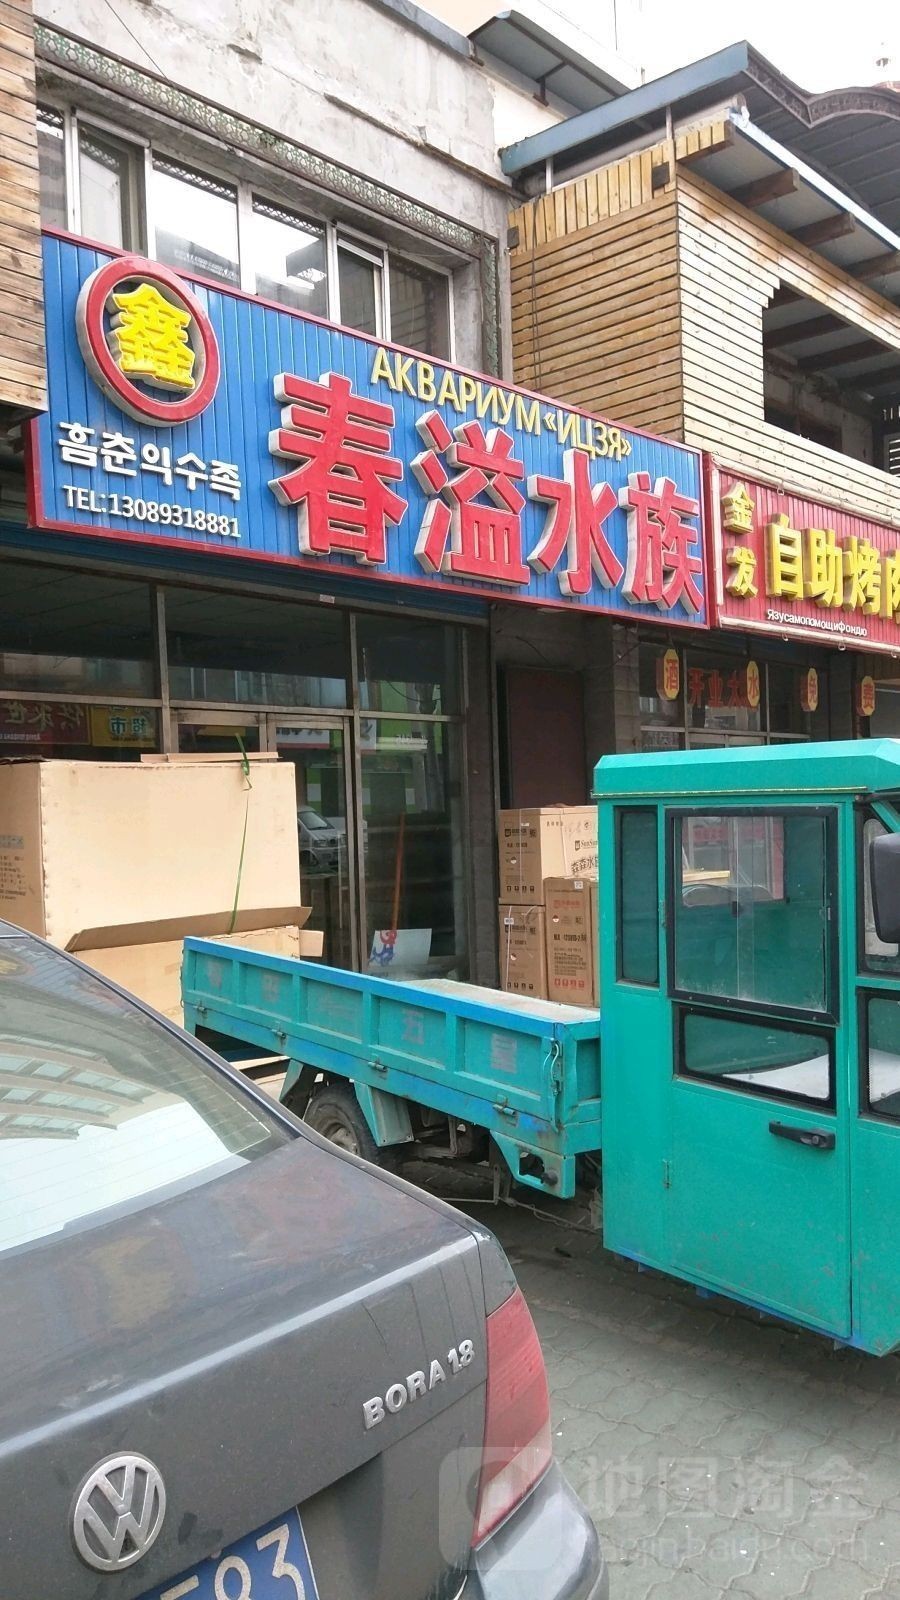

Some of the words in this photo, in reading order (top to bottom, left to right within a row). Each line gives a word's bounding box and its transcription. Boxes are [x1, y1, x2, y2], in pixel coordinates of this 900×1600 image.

[110, 283, 196, 391] 鑫
[268, 371, 704, 615] 春溢水族
[722, 481, 759, 600] 金发
[362, 1359, 447, 1430] BORA
